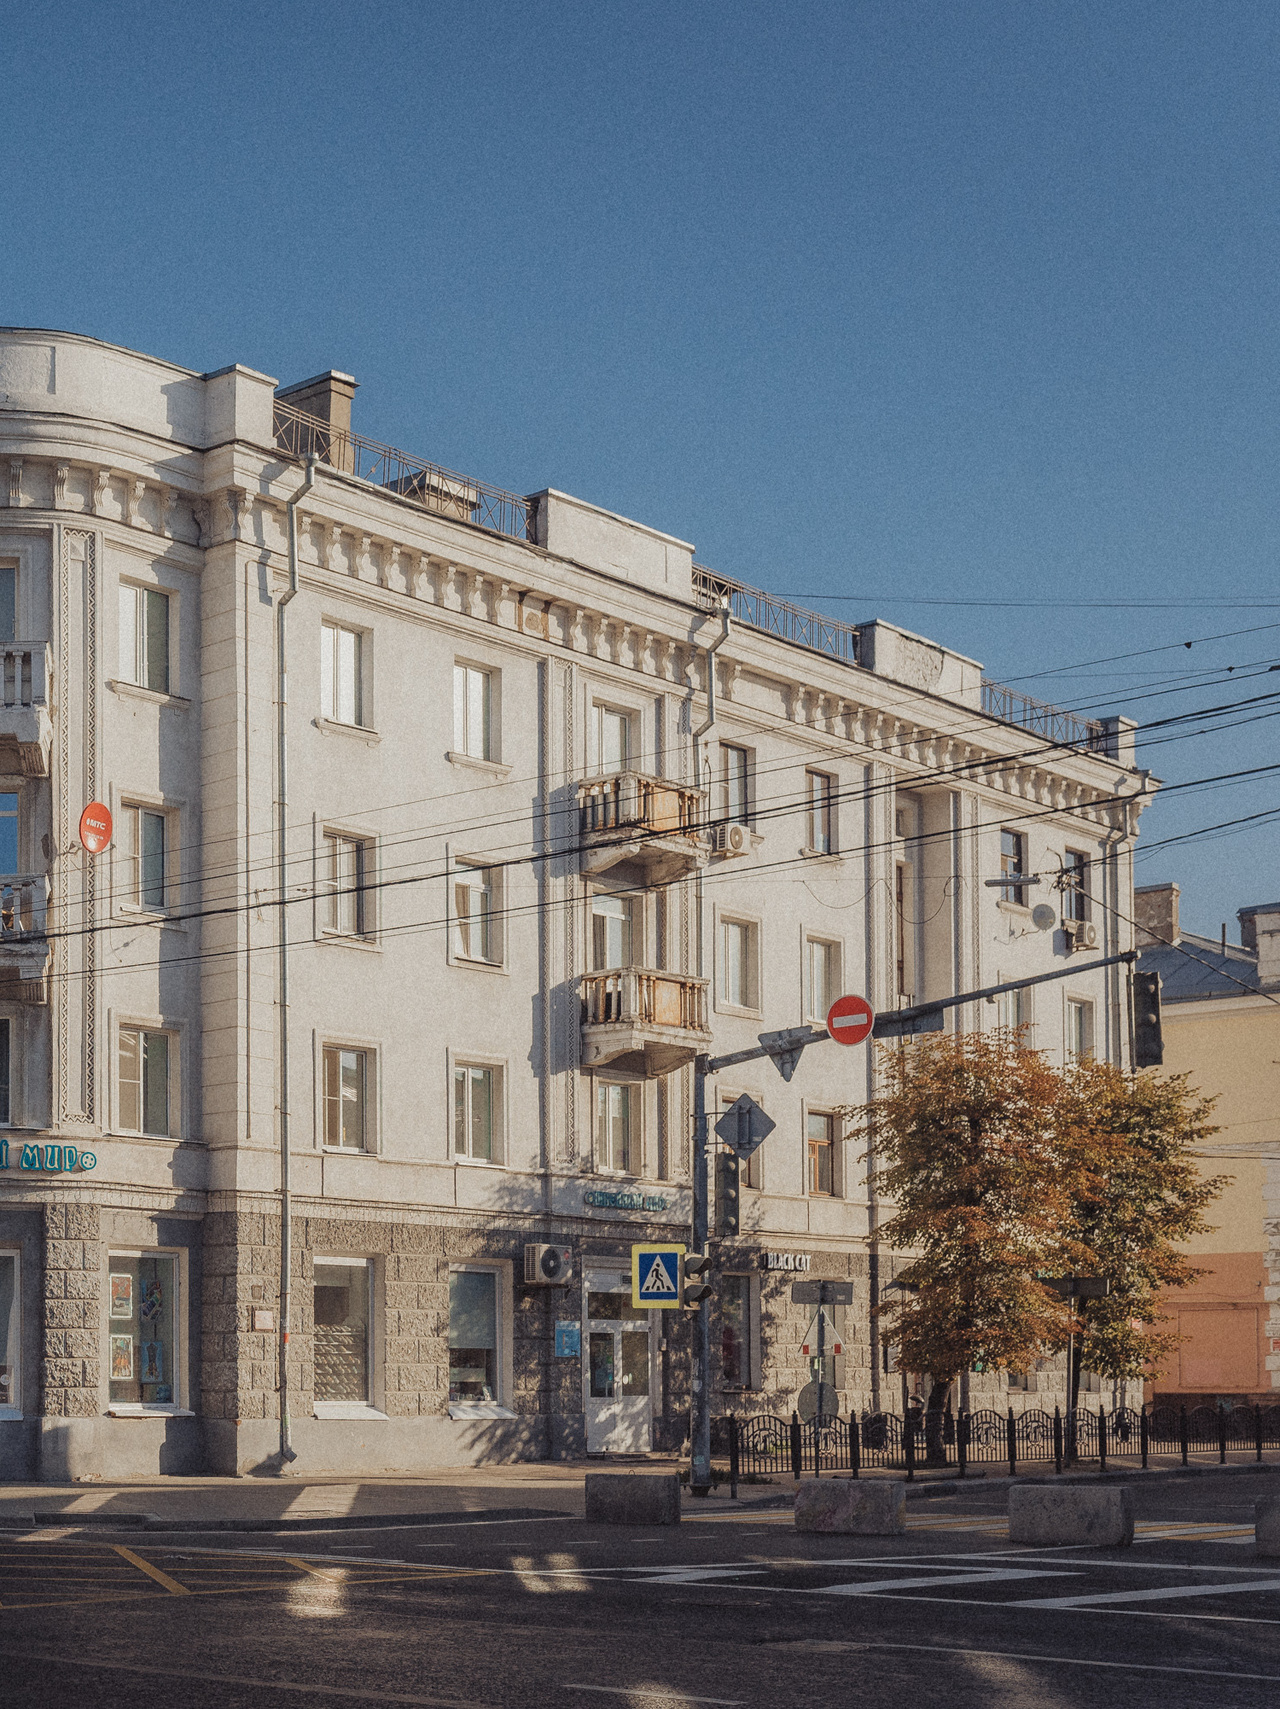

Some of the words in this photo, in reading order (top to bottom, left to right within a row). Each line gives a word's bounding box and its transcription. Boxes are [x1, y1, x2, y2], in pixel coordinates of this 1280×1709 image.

[20, 1143, 78, 1172] МИР
[767, 1252, 795, 1270] BLACK
[795, 1254, 812, 1271] CAT
